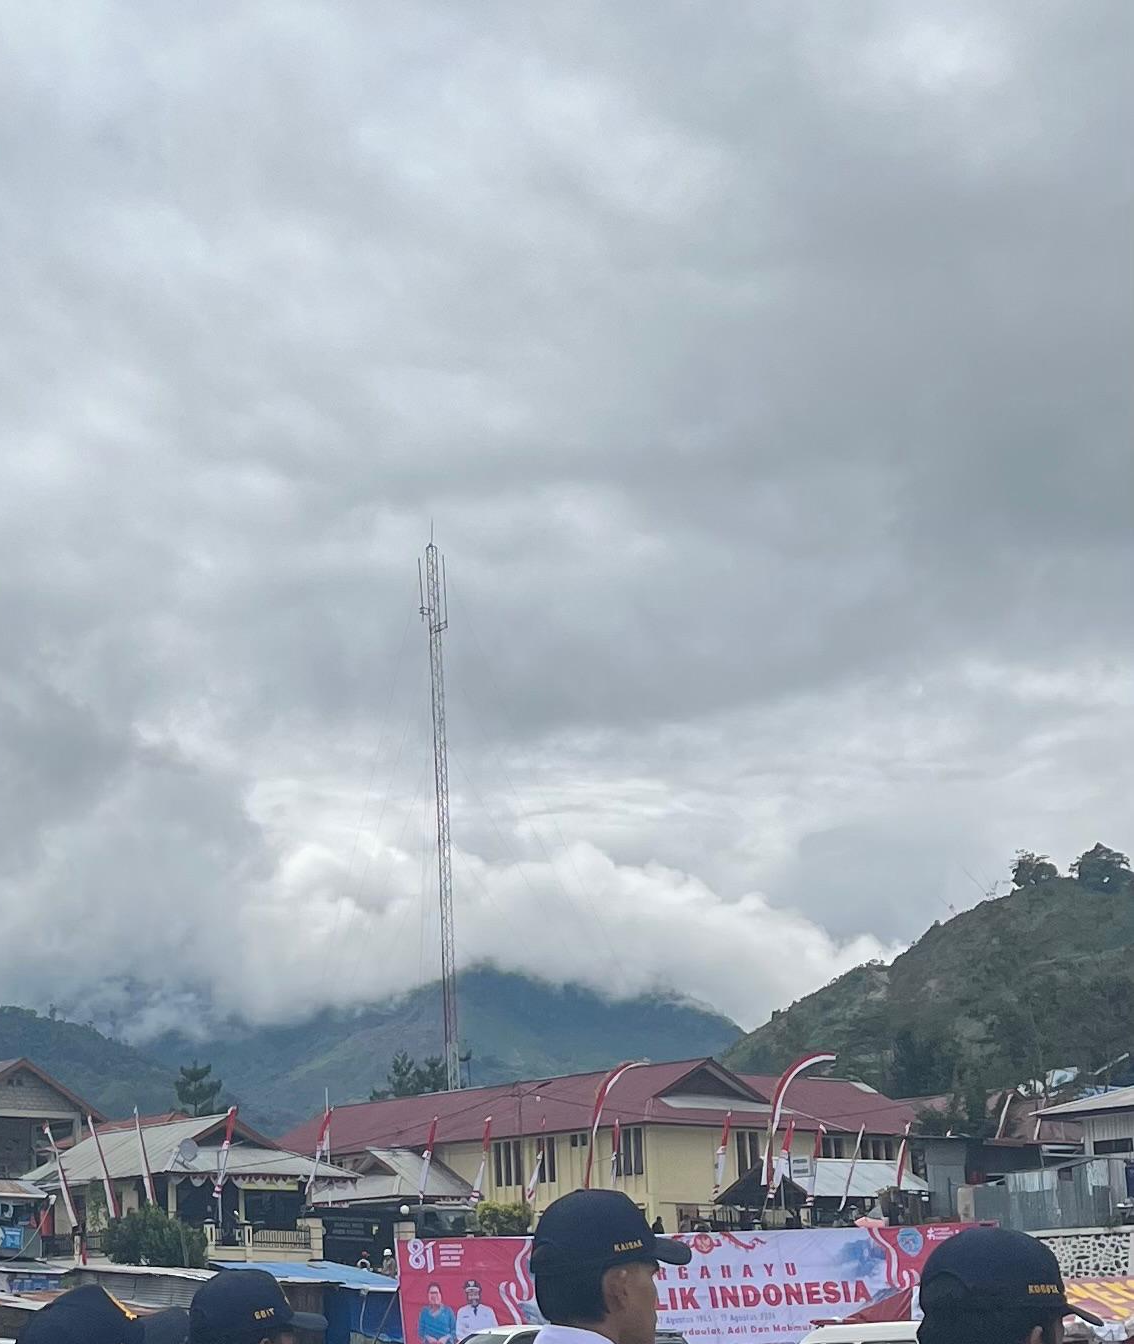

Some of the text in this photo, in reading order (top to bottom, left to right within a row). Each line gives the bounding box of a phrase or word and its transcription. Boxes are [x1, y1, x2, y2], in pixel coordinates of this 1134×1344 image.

[407, 1238, 436, 1274] 81
[657, 1262, 797, 1280] RGAHAYU
[708, 1280, 872, 1309] INDONESIA
[683, 1326, 724, 1336] rdaulat,
[727, 1325, 747, 1335] Adil
